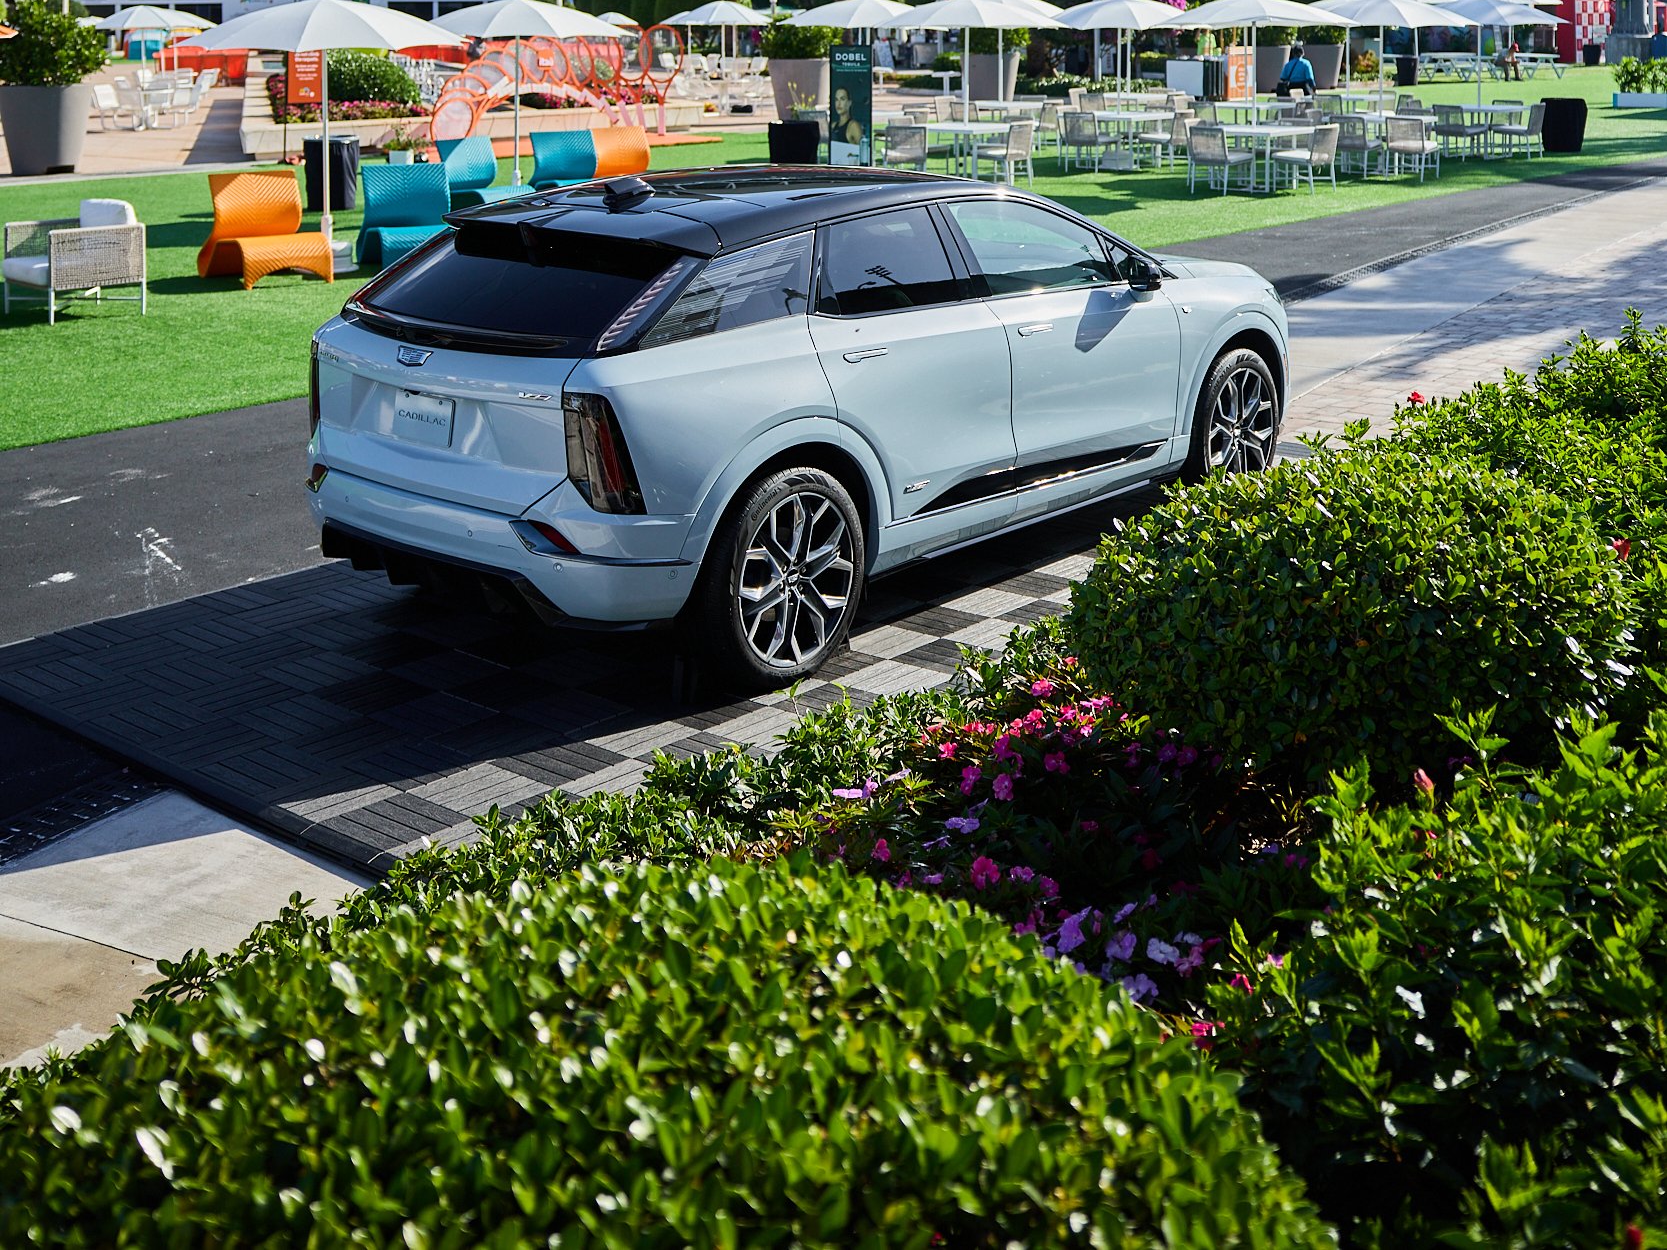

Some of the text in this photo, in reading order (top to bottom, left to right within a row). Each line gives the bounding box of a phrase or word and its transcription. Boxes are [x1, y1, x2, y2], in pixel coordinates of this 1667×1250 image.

[835, 53, 867, 61] DOBEL
[398, 409, 446, 427] CADILLAC
[751, 488, 778, 521] Continental
